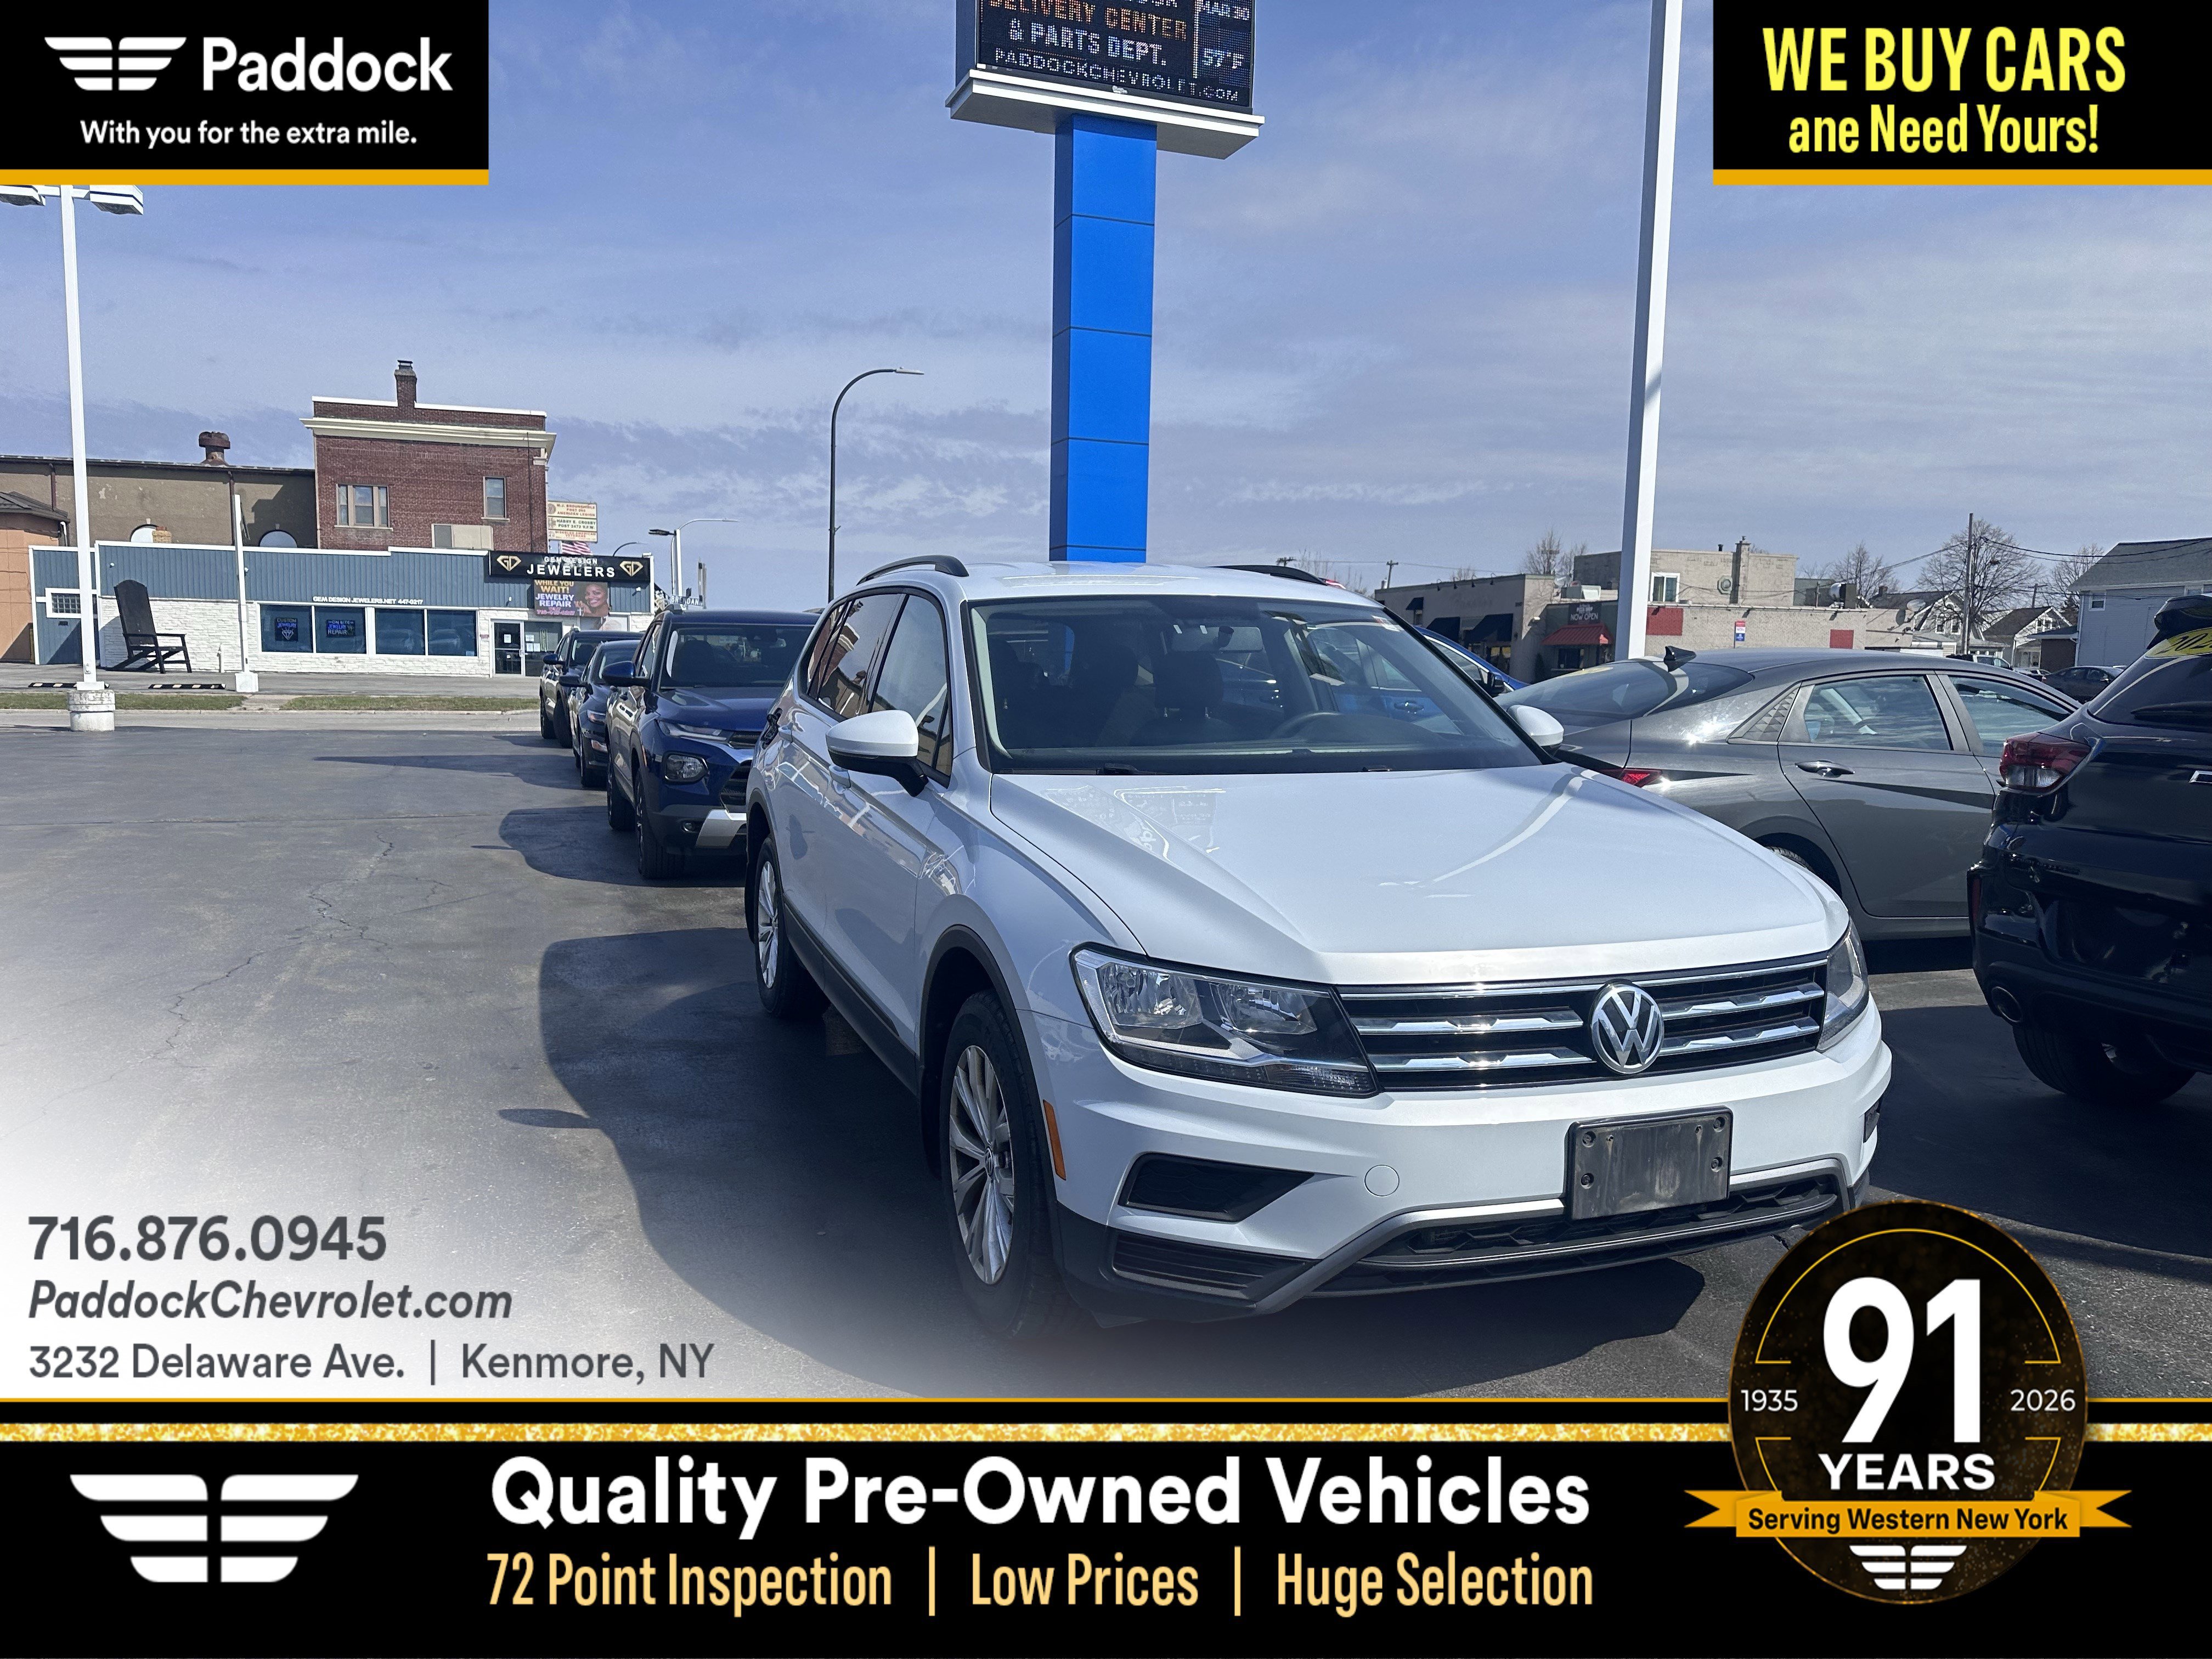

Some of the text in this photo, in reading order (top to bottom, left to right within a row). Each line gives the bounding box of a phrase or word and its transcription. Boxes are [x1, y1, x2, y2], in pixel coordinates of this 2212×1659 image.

[1008, 18, 1166, 66] & PARTS DEPT.
[1104, 8, 1187, 41] CENTER
[995, 48, 1238, 101] PADDOCKCHEVROLET.COM
[527, 564, 615, 577] JEWELERS
[1592, 985, 1664, 1074] VW
